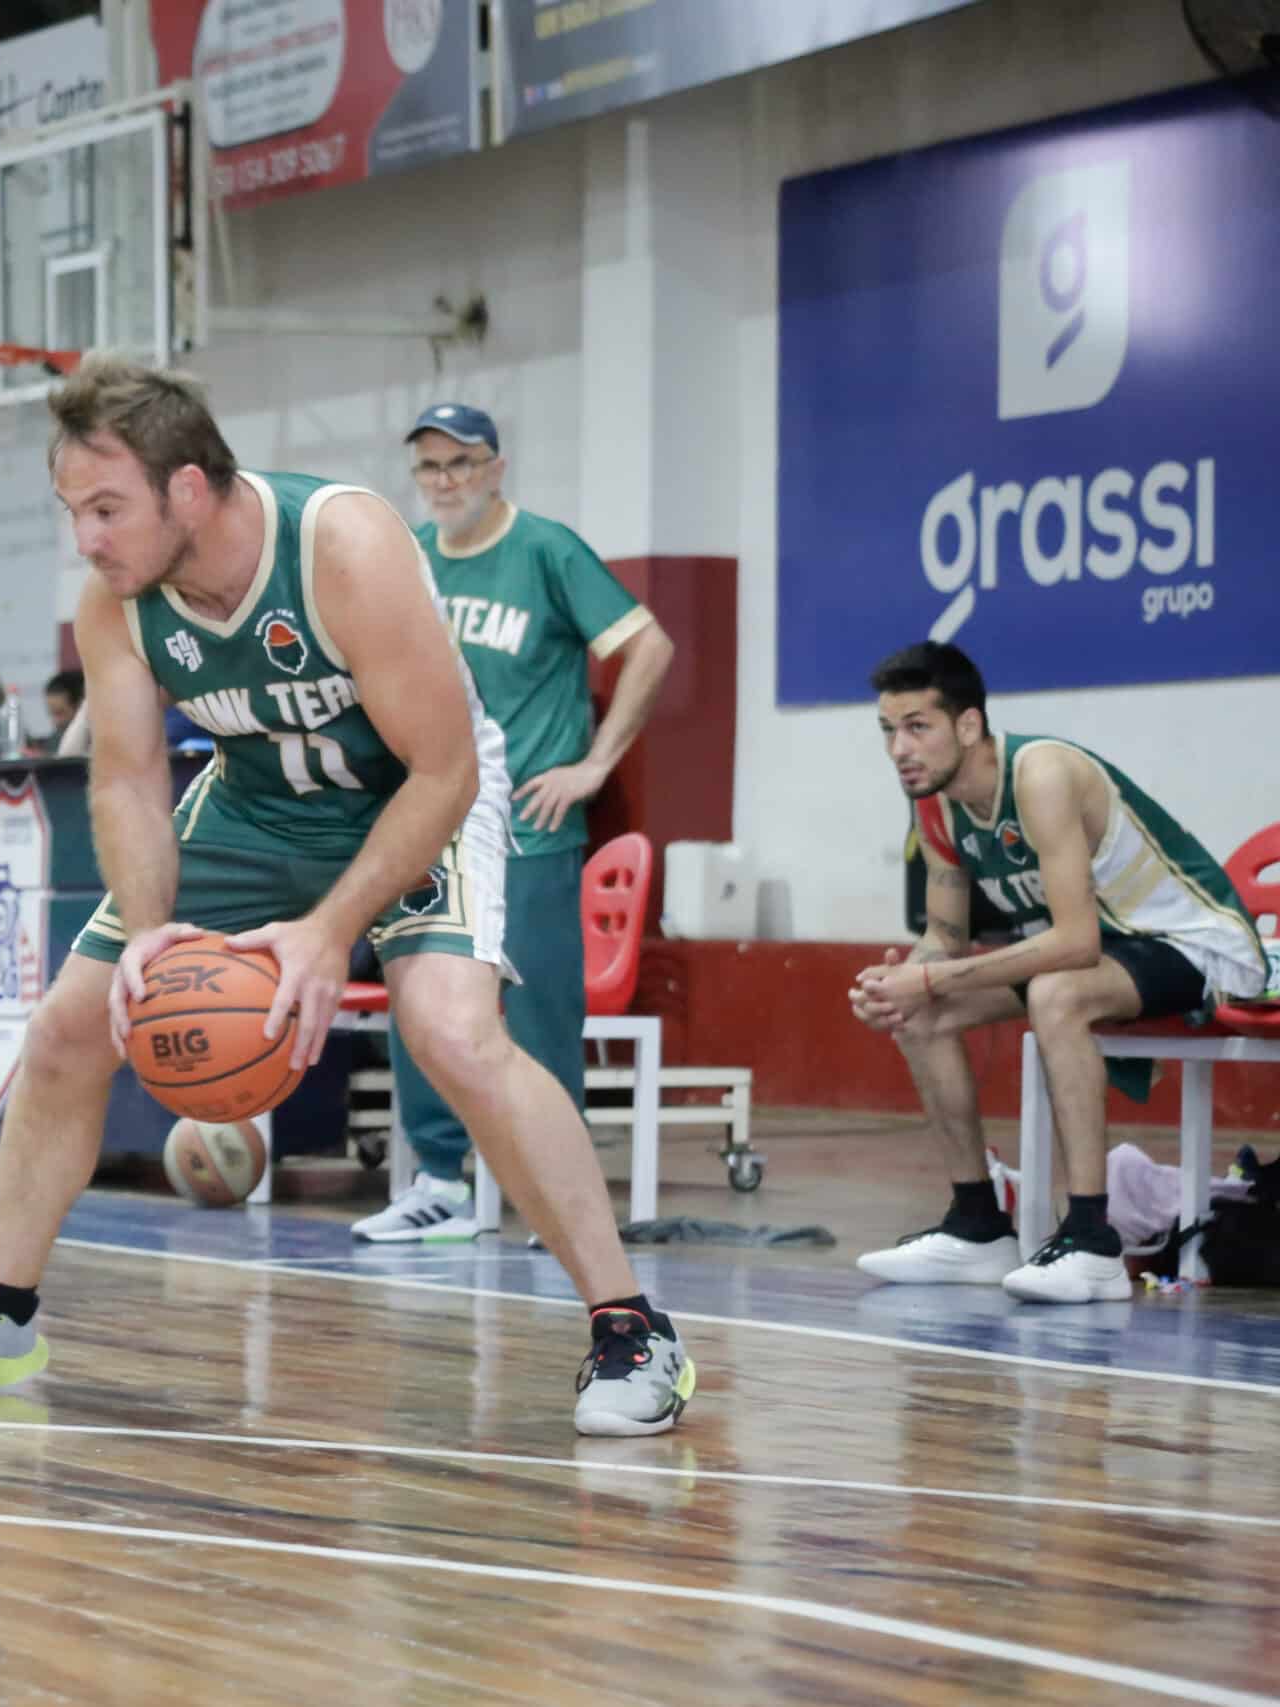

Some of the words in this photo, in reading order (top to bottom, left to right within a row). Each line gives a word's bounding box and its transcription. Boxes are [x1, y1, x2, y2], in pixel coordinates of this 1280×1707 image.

[920, 458, 1216, 644] grassi
[449, 596, 530, 656] TEAM
[1141, 581, 1214, 624] grupo
[266, 730, 364, 796] 11
[150, 1027, 210, 1058] BIG
